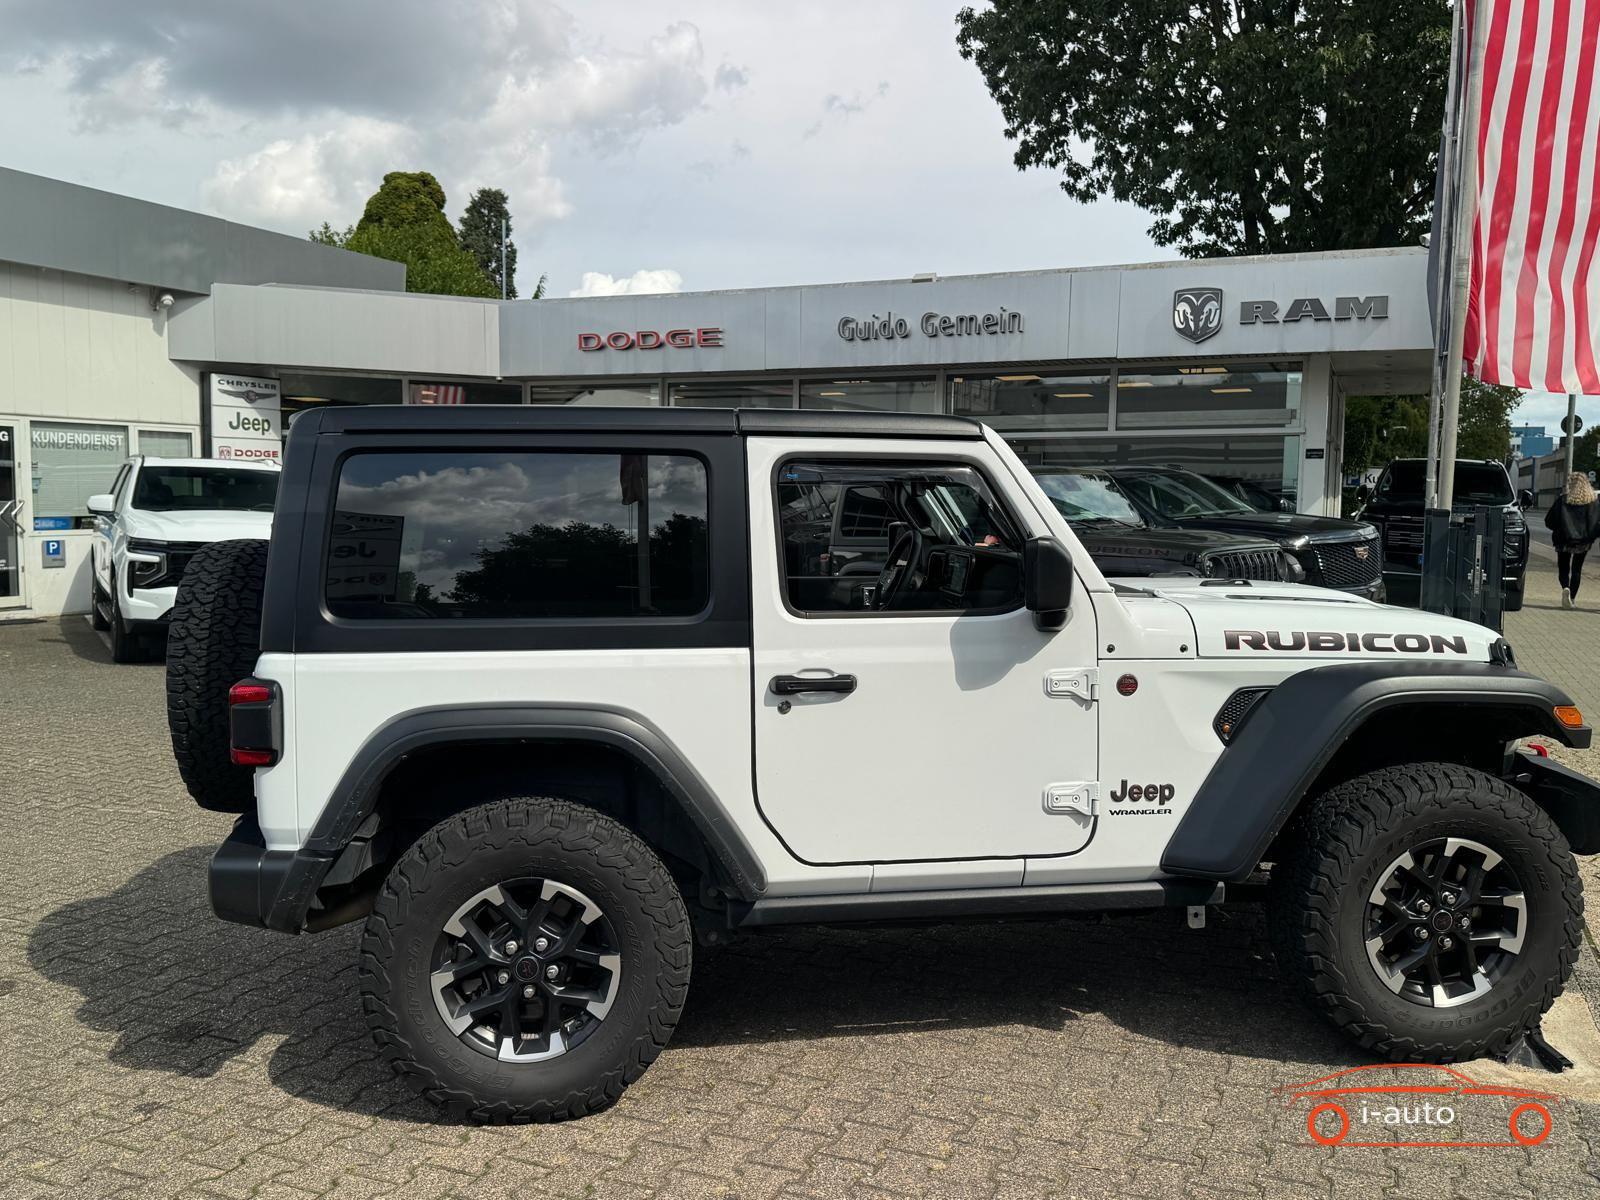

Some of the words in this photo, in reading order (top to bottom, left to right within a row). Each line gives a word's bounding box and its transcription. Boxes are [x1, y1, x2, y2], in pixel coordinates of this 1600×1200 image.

[1240, 296, 1389, 325] RAM
[838, 312, 910, 341] Guido
[921, 306, 1024, 337] Gemein
[578, 328, 723, 351] DODGE
[218, 379, 277, 390] CHRYSLER
[228, 411, 271, 436] Jeep
[32, 431, 124, 446] KUNDENDIENST
[234, 449, 279, 458] DODGE
[49, 542, 58, 554] P
[1087, 545, 1170, 557] UBICON
[1223, 630, 1468, 654] RUBICON
[1110, 779, 1175, 806] Jeep
